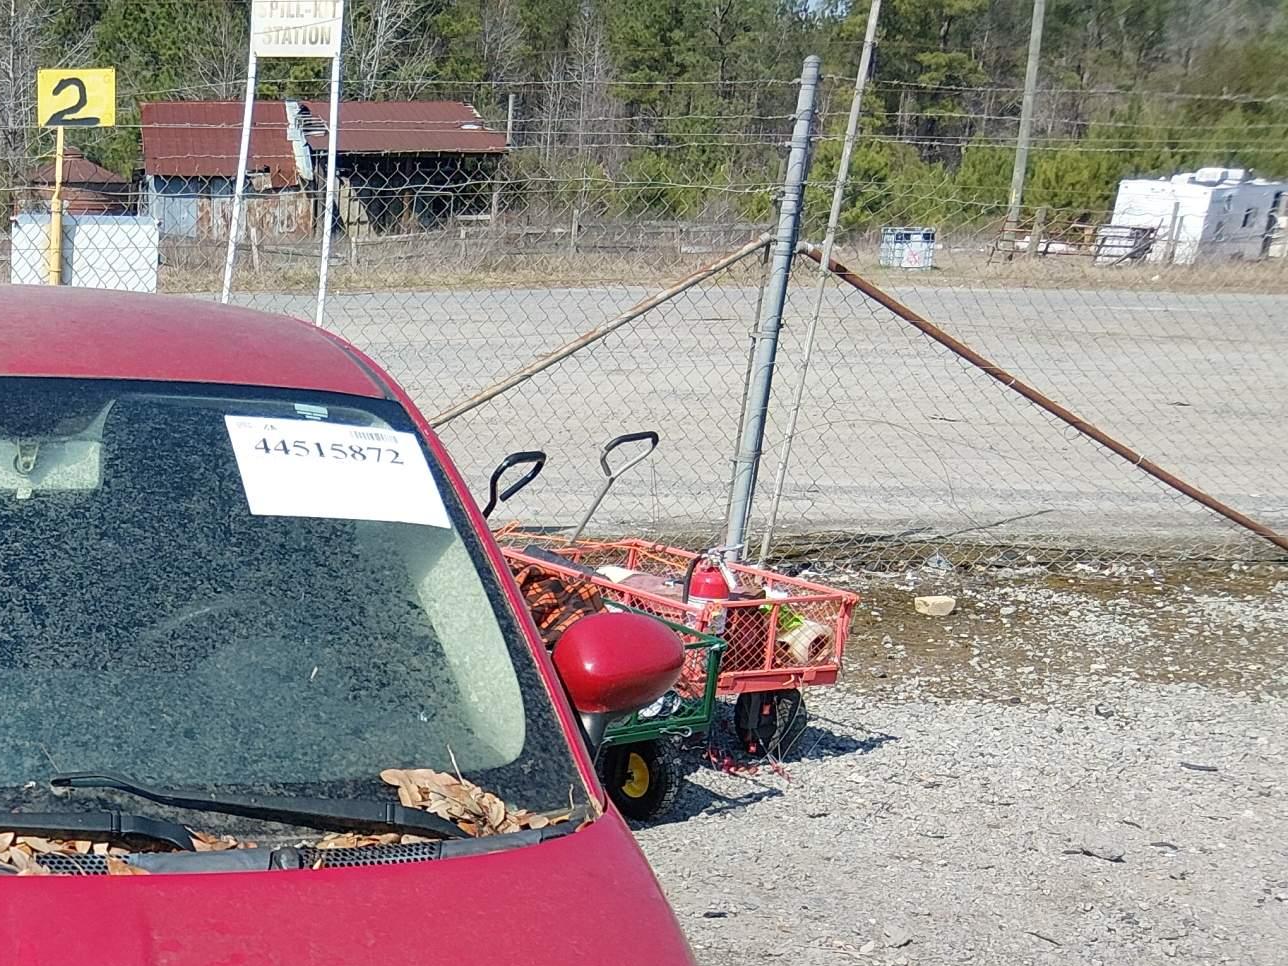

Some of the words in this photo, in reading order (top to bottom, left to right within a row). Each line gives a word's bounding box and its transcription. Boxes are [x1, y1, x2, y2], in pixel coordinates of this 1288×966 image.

[262, 26, 331, 45] STATION
[45, 77, 100, 126] 2
[254, 437, 405, 465] 44515872
